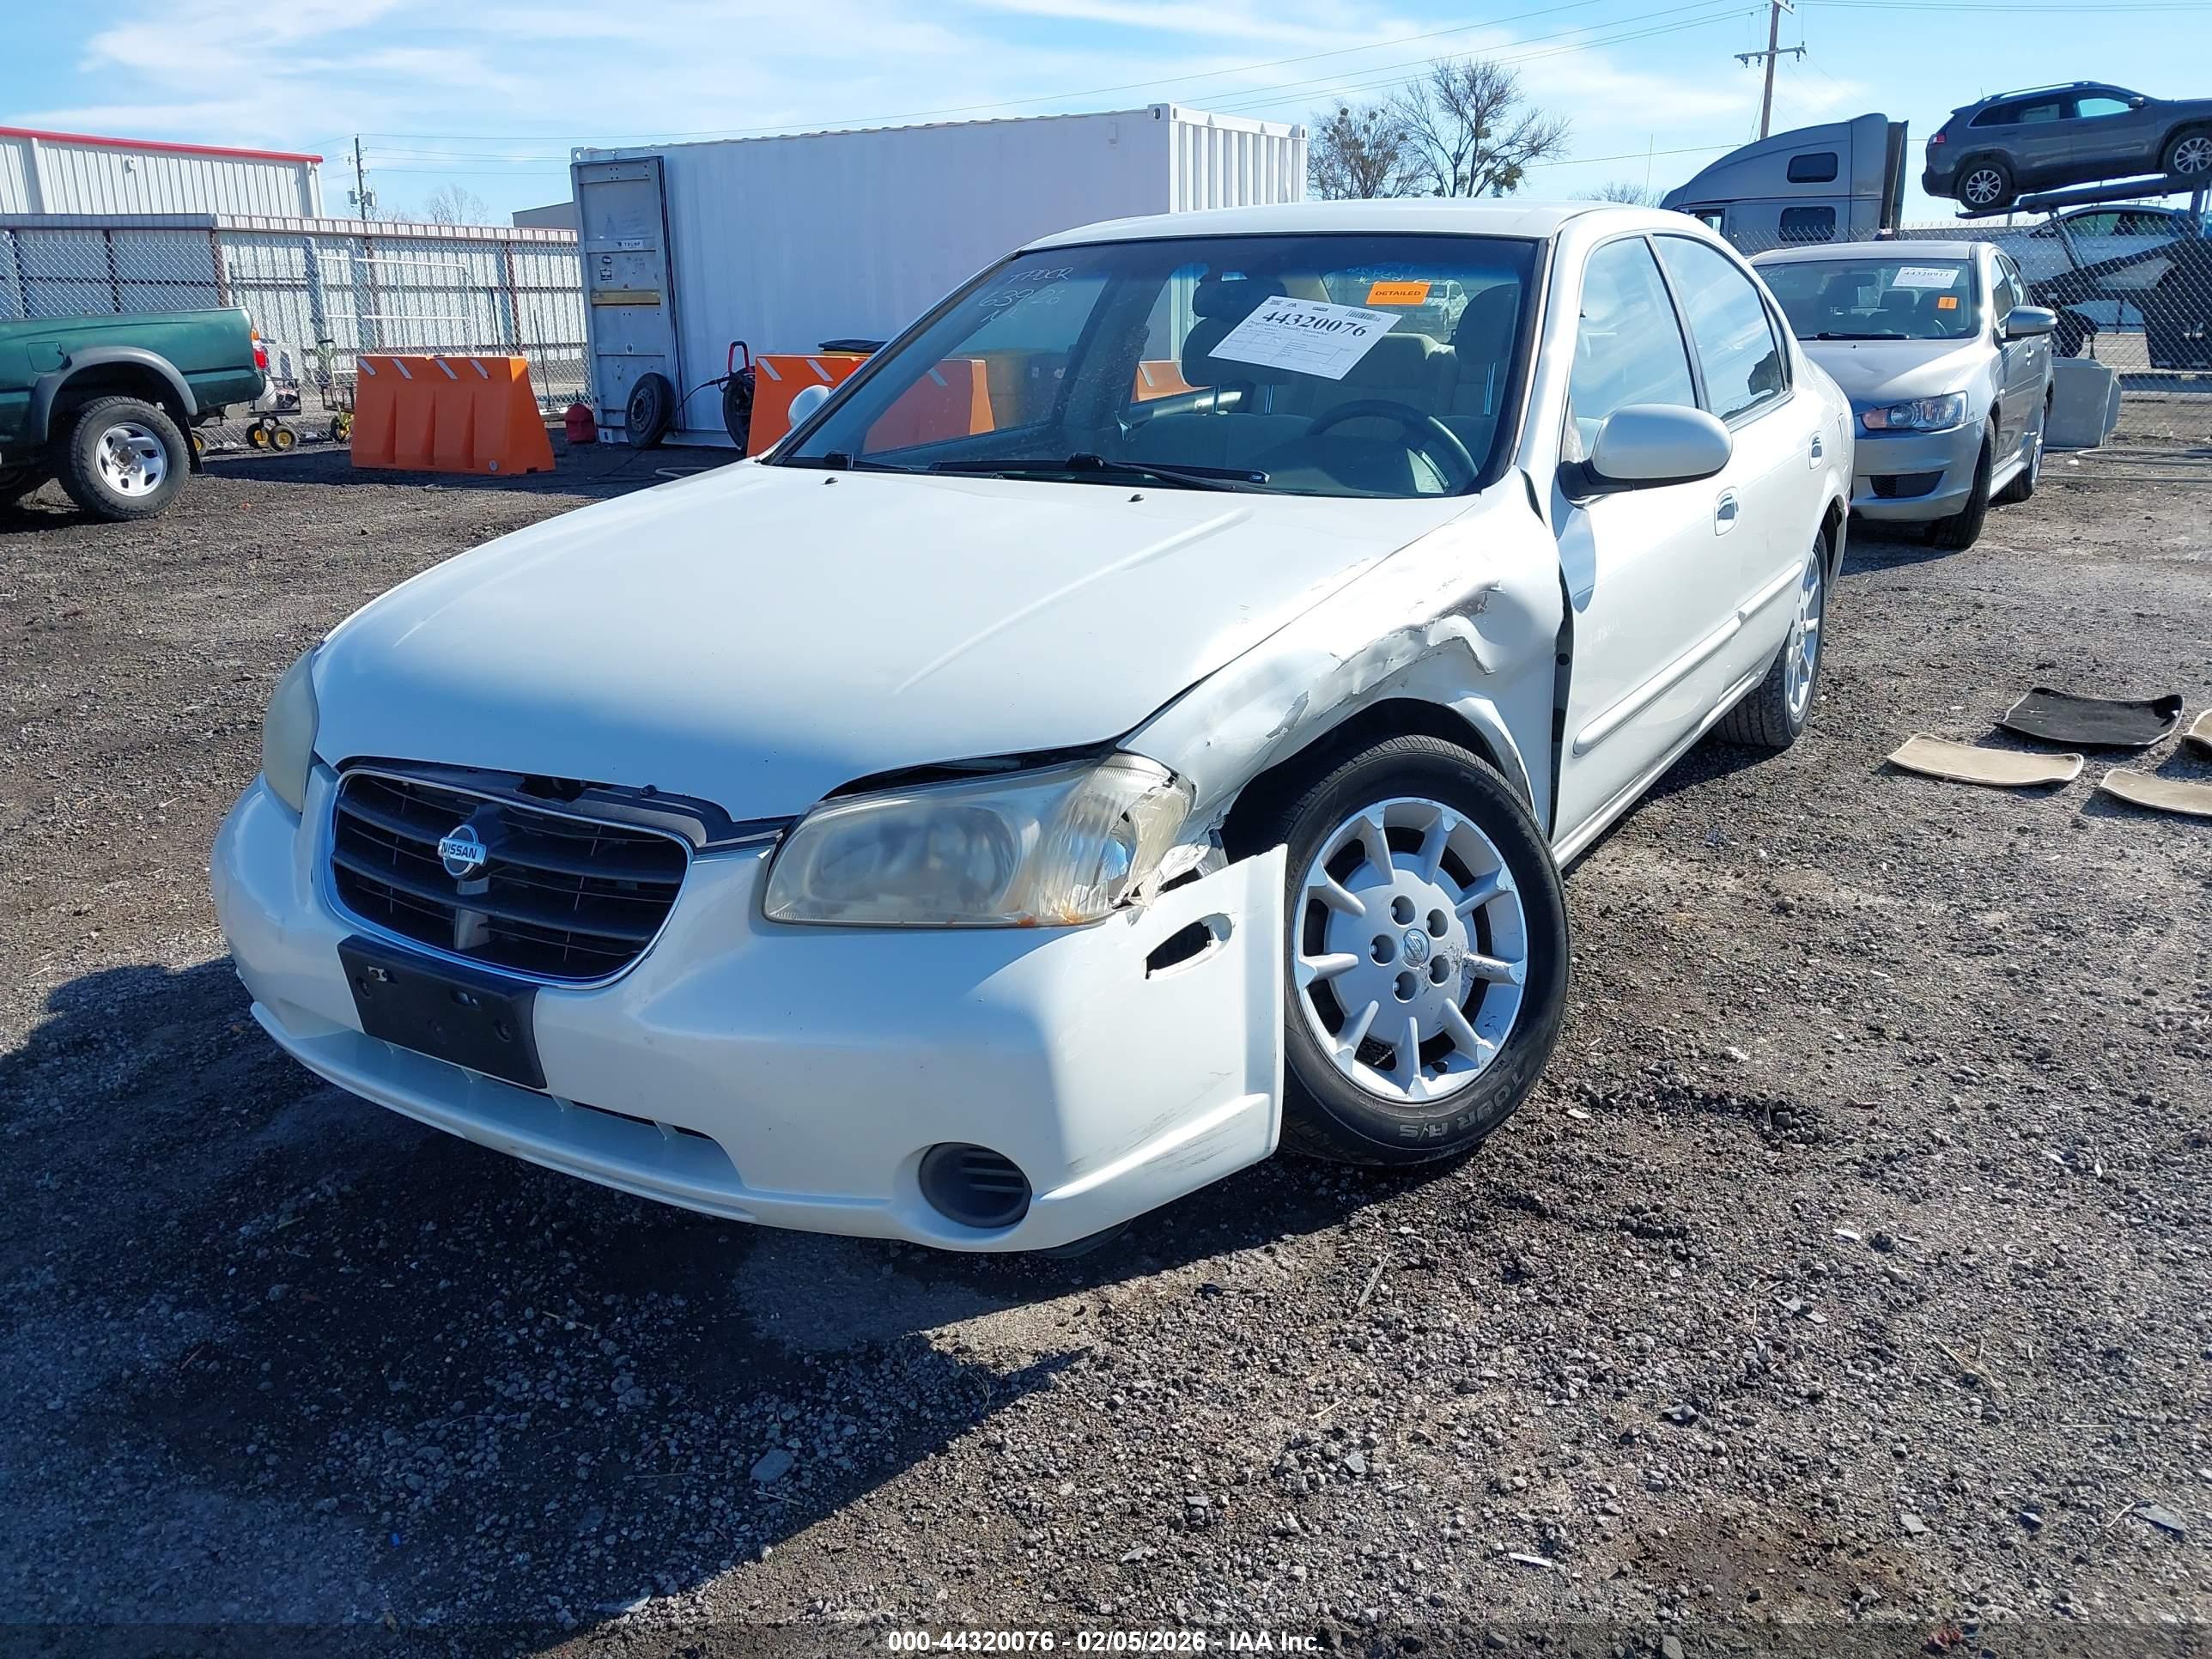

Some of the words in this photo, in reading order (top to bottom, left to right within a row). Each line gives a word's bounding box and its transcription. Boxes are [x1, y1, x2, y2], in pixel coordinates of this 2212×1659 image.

[1261, 310, 1374, 337] 44320076
[441, 842, 477, 860] NISSAN
[1456, 1073, 1525, 1129] TOUR
[1399, 1121, 1449, 1142] A/S
